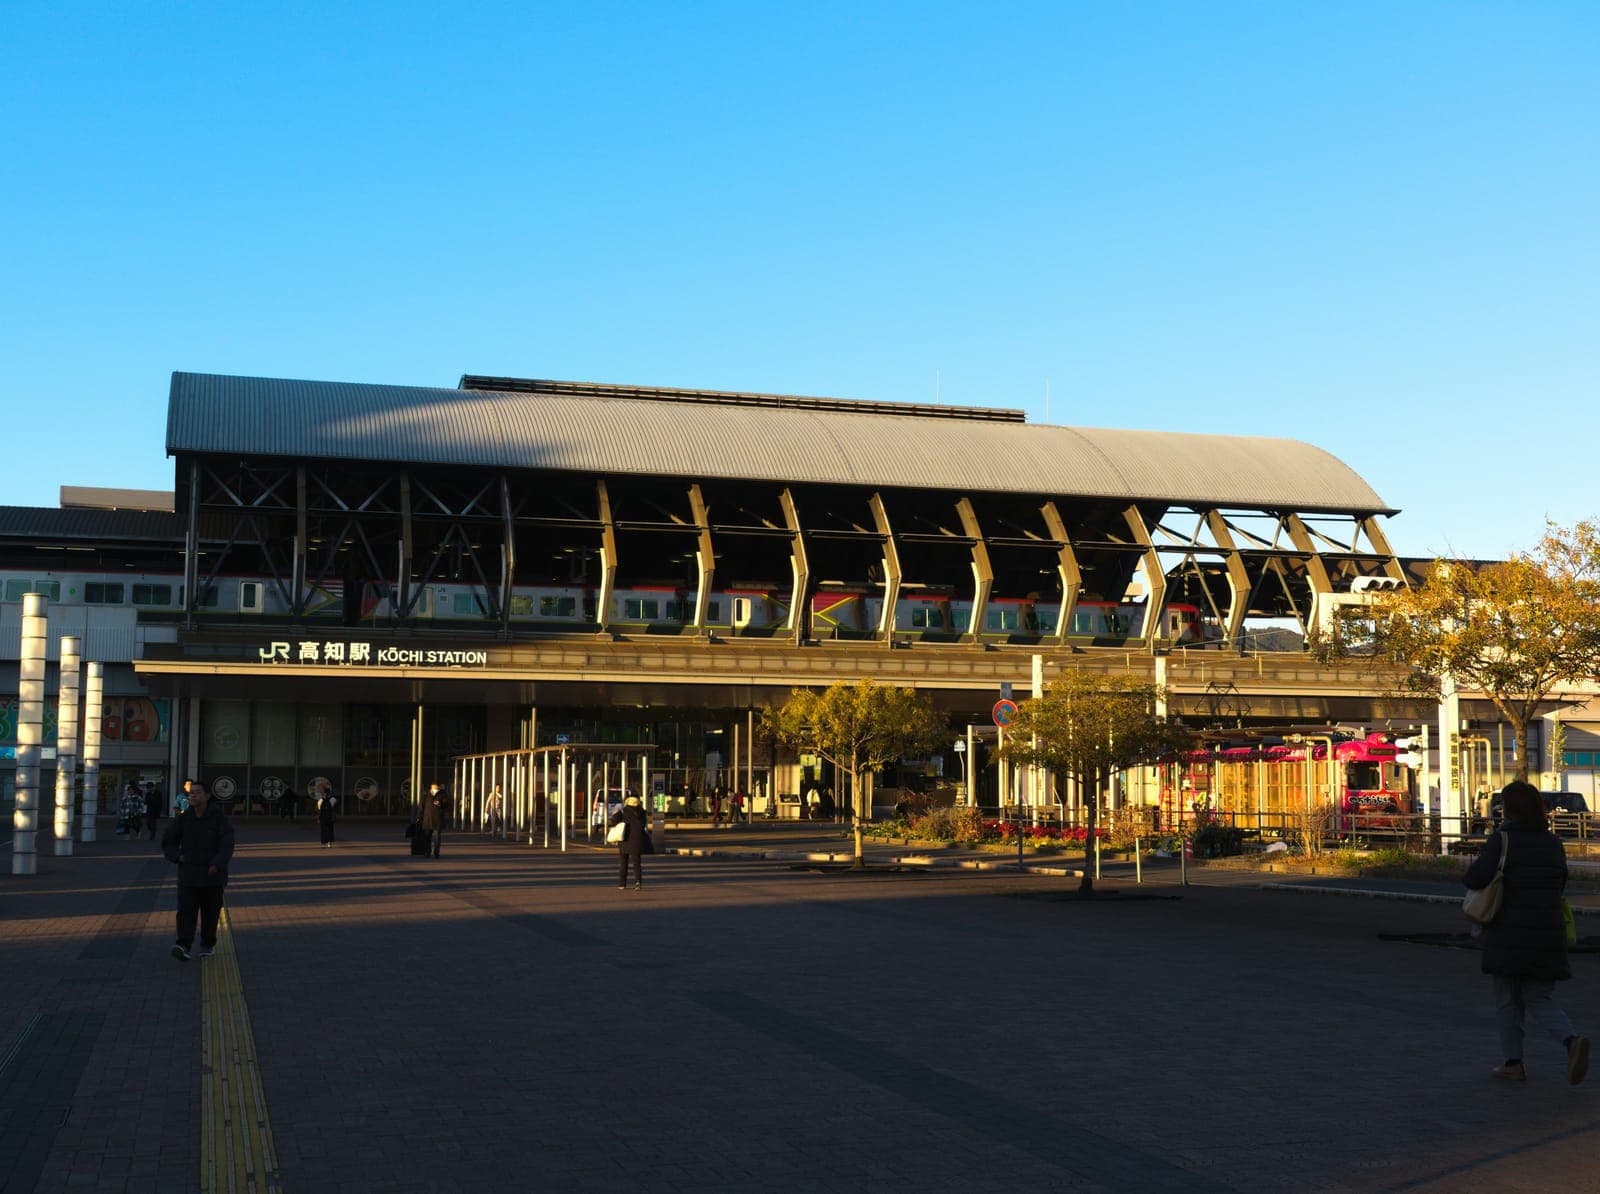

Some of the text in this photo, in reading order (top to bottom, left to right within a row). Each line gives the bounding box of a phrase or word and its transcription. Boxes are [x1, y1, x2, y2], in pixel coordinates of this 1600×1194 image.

[259, 642, 487, 664] JR 高知駅 KŌCHI STATION
